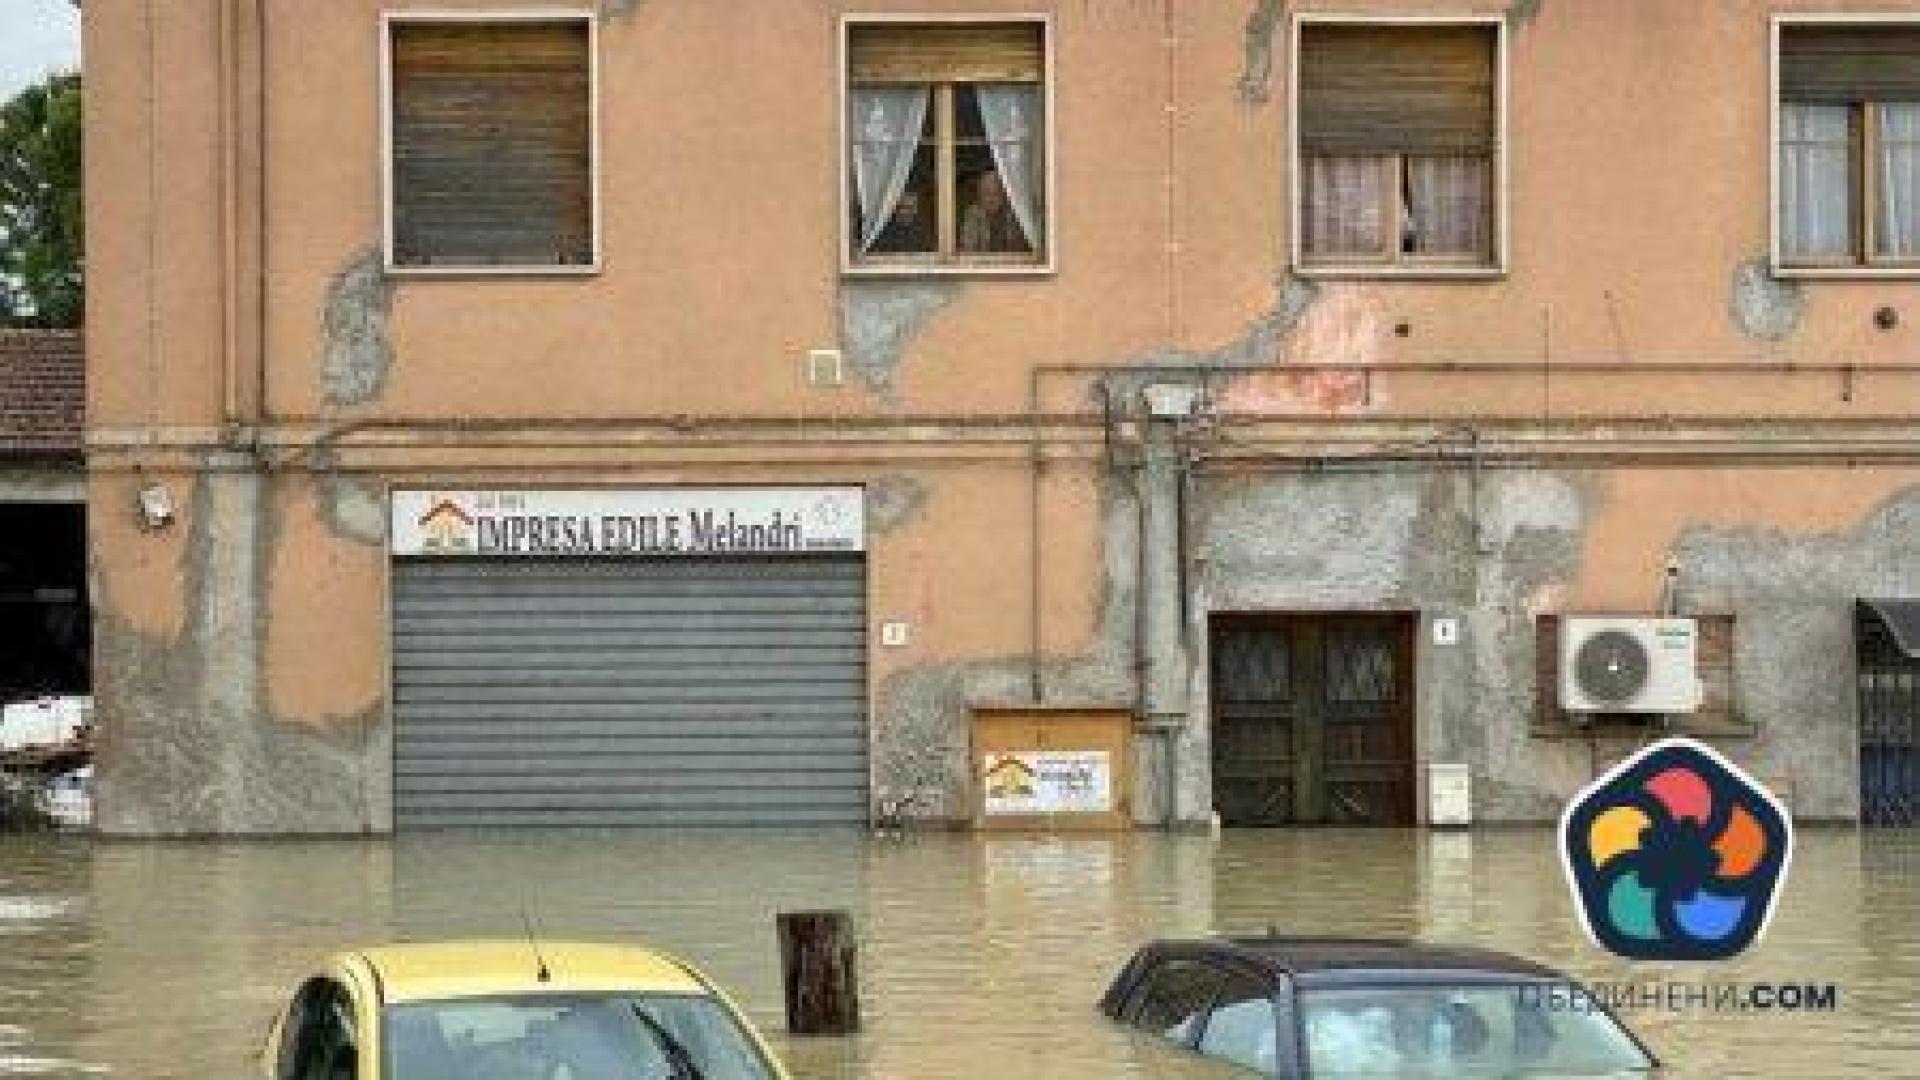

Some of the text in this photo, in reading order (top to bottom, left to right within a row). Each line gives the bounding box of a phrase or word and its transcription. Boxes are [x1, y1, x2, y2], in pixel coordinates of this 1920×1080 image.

[475, 508, 802, 552] IMPRESA EDILE Melandri
